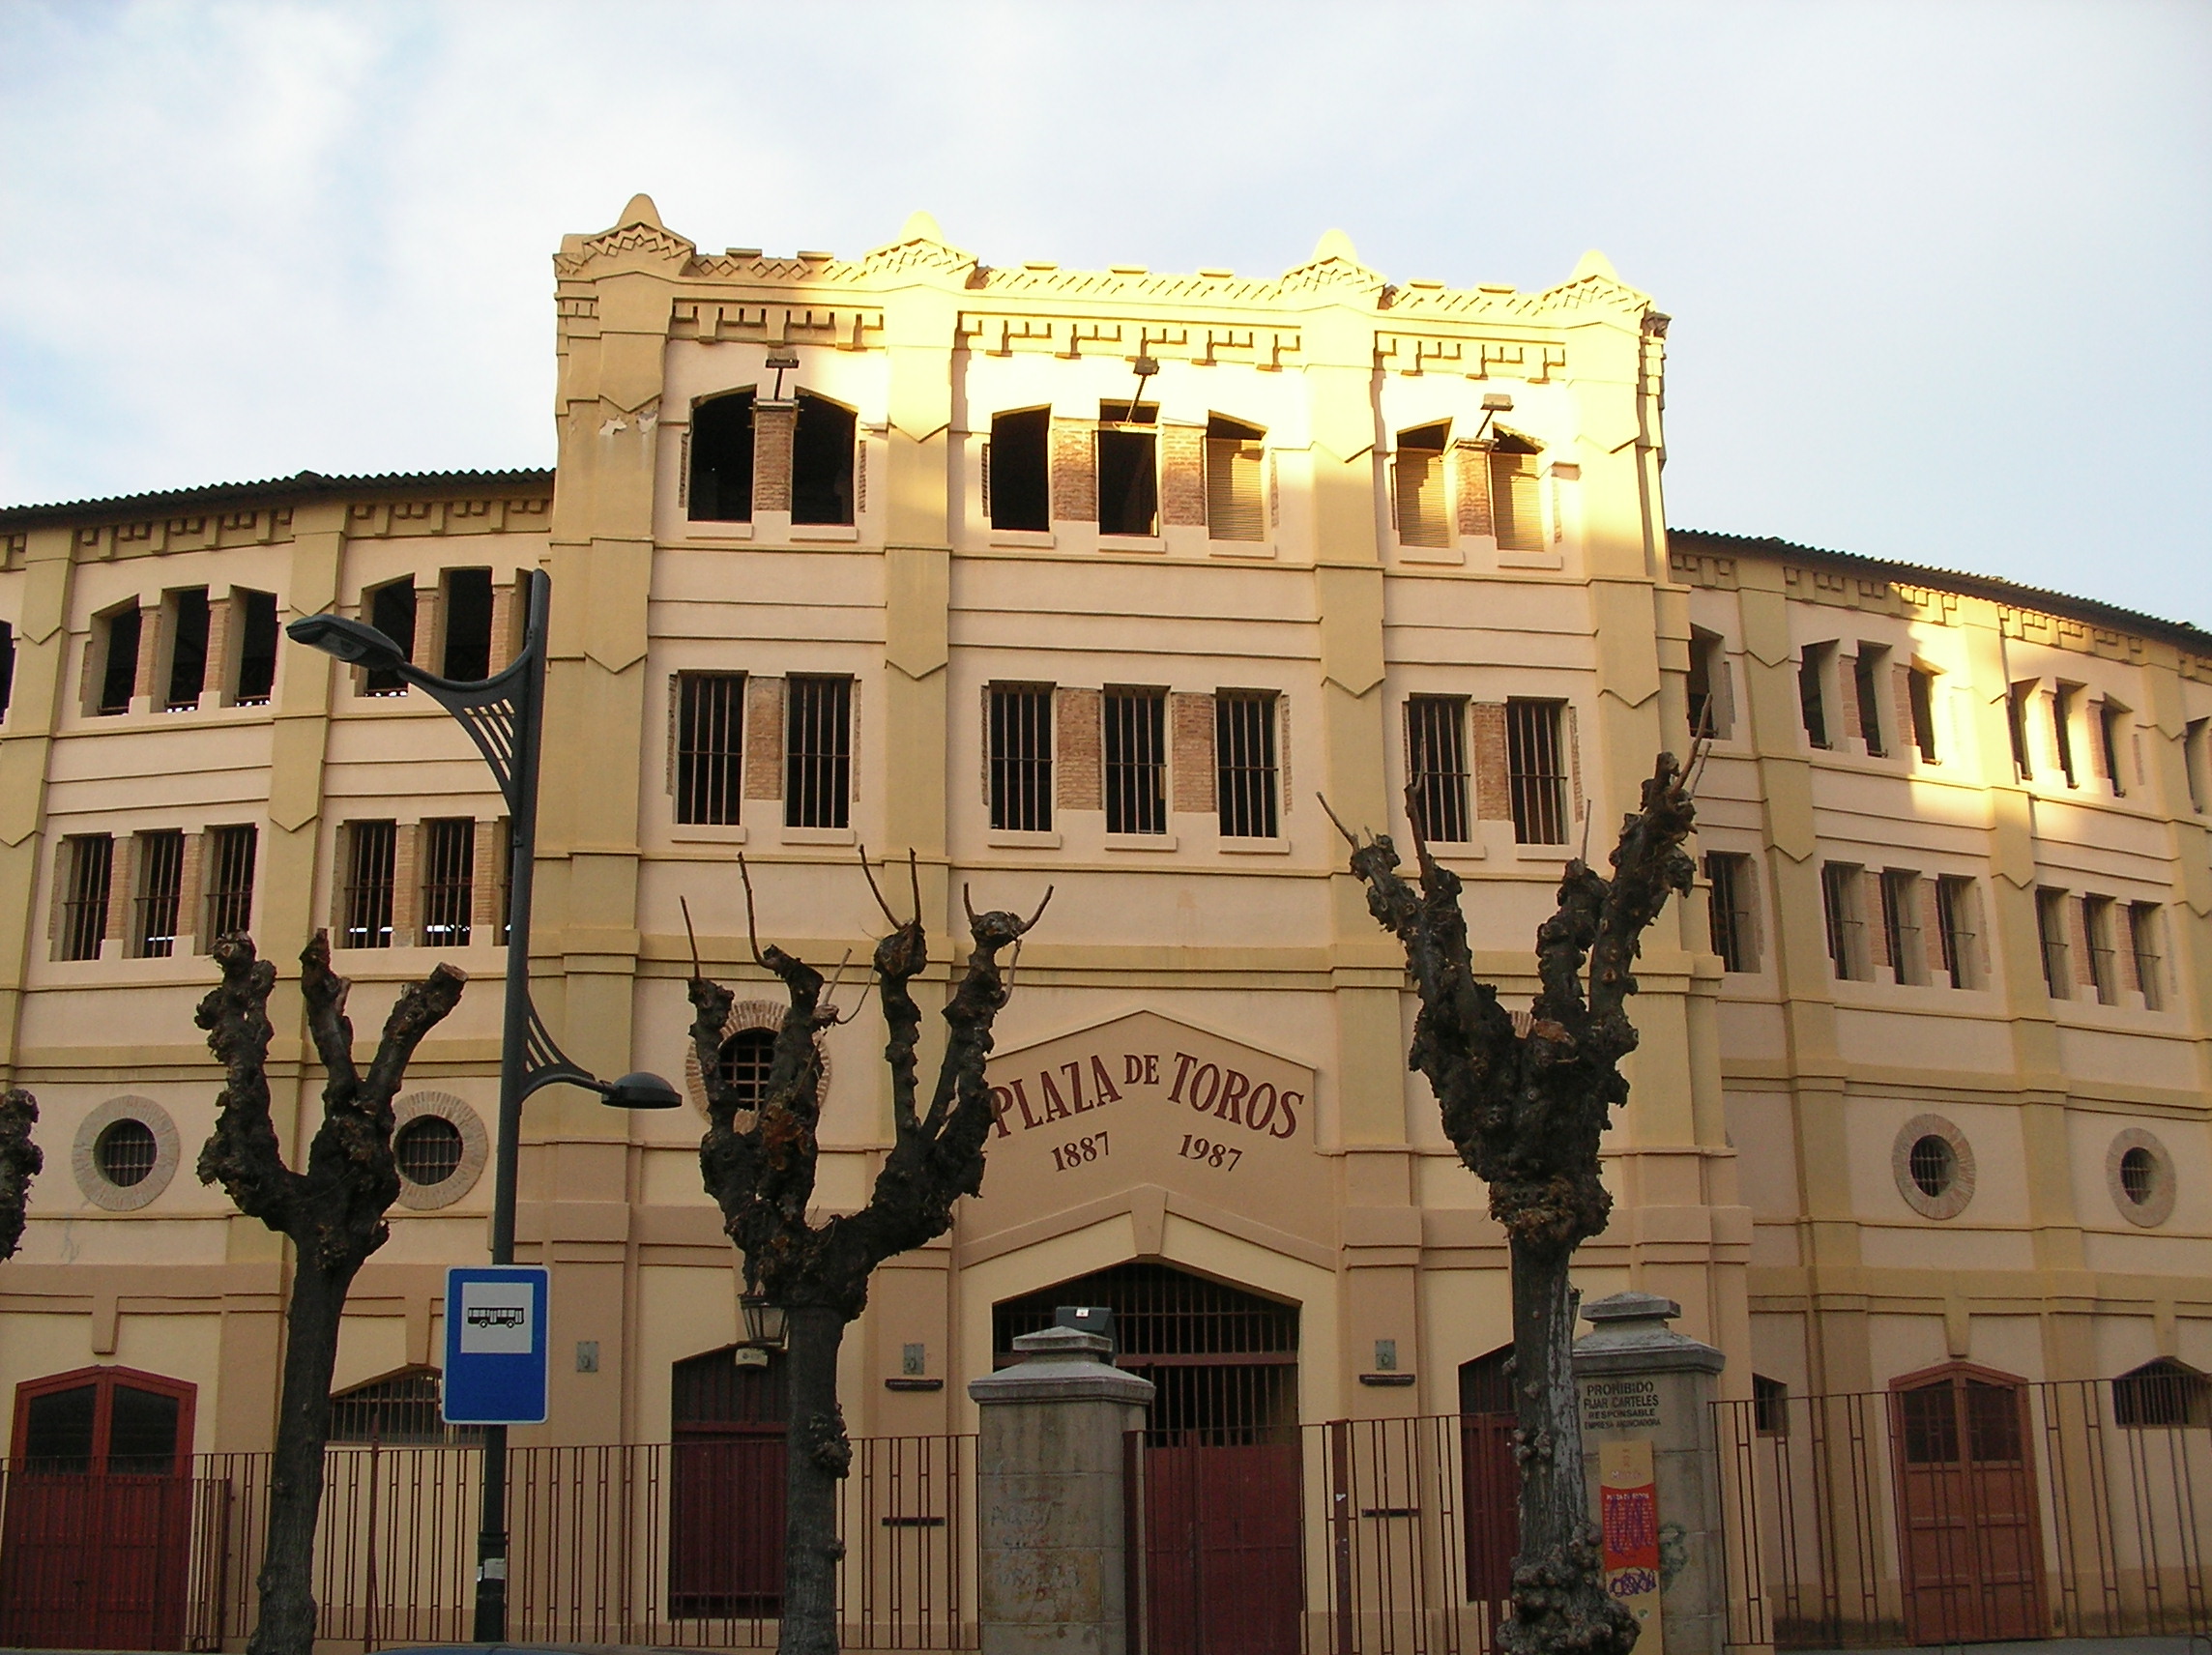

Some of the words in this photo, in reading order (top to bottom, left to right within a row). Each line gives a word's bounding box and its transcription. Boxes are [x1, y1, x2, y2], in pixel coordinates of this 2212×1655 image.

[991, 1055, 1122, 1138] PLAZA
[1123, 1054, 1159, 1085] DE
[1167, 1051, 1304, 1139] TOROS
[1051, 1131, 1110, 1172] 1887
[1178, 1134, 1242, 1172] 1987
[1584, 1398, 1609, 1409] FIJAR
[1612, 1394, 1659, 1408] CARTELES
[1586, 1380, 1654, 1397] PROHIBIDO
[1588, 1408, 1655, 1419] RESPONSABLE
